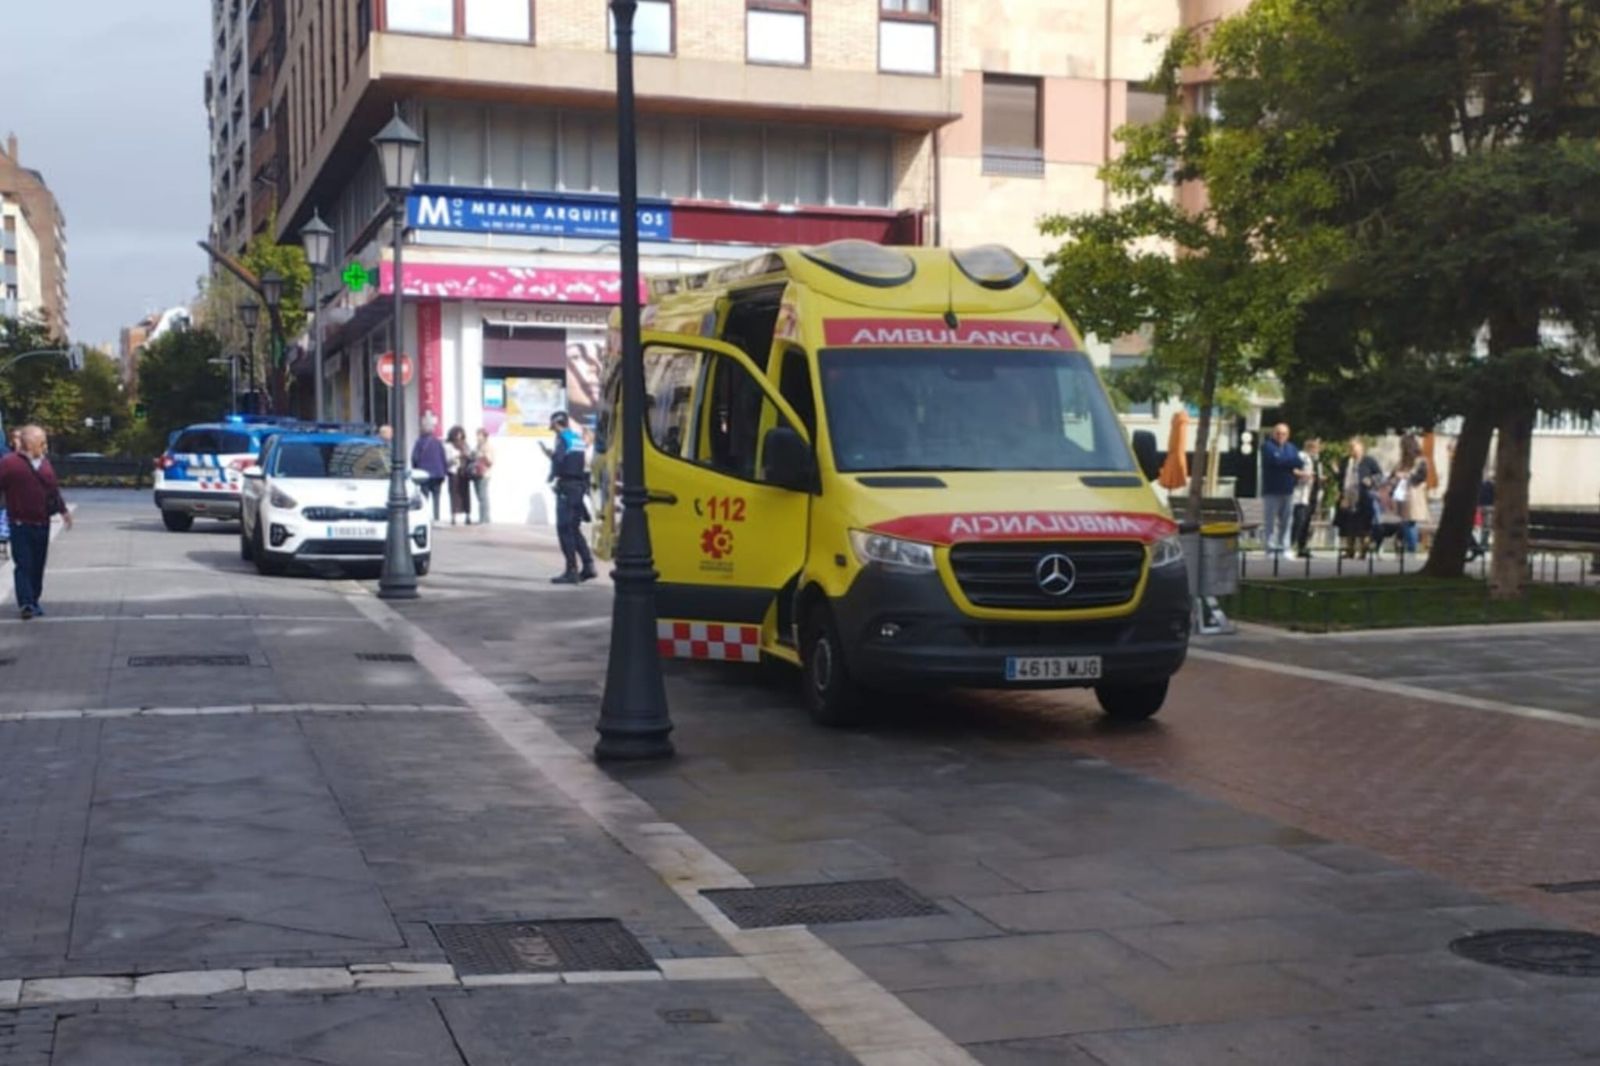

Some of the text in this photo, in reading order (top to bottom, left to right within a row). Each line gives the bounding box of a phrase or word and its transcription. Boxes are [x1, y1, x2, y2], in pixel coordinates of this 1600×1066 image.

[417, 195, 450, 226] M
[471, 202, 535, 218] MEANA
[852, 327, 1061, 346] AMBULANCIA
[706, 496, 746, 522] 112
[1019, 659, 1098, 678] 4613 MJG
